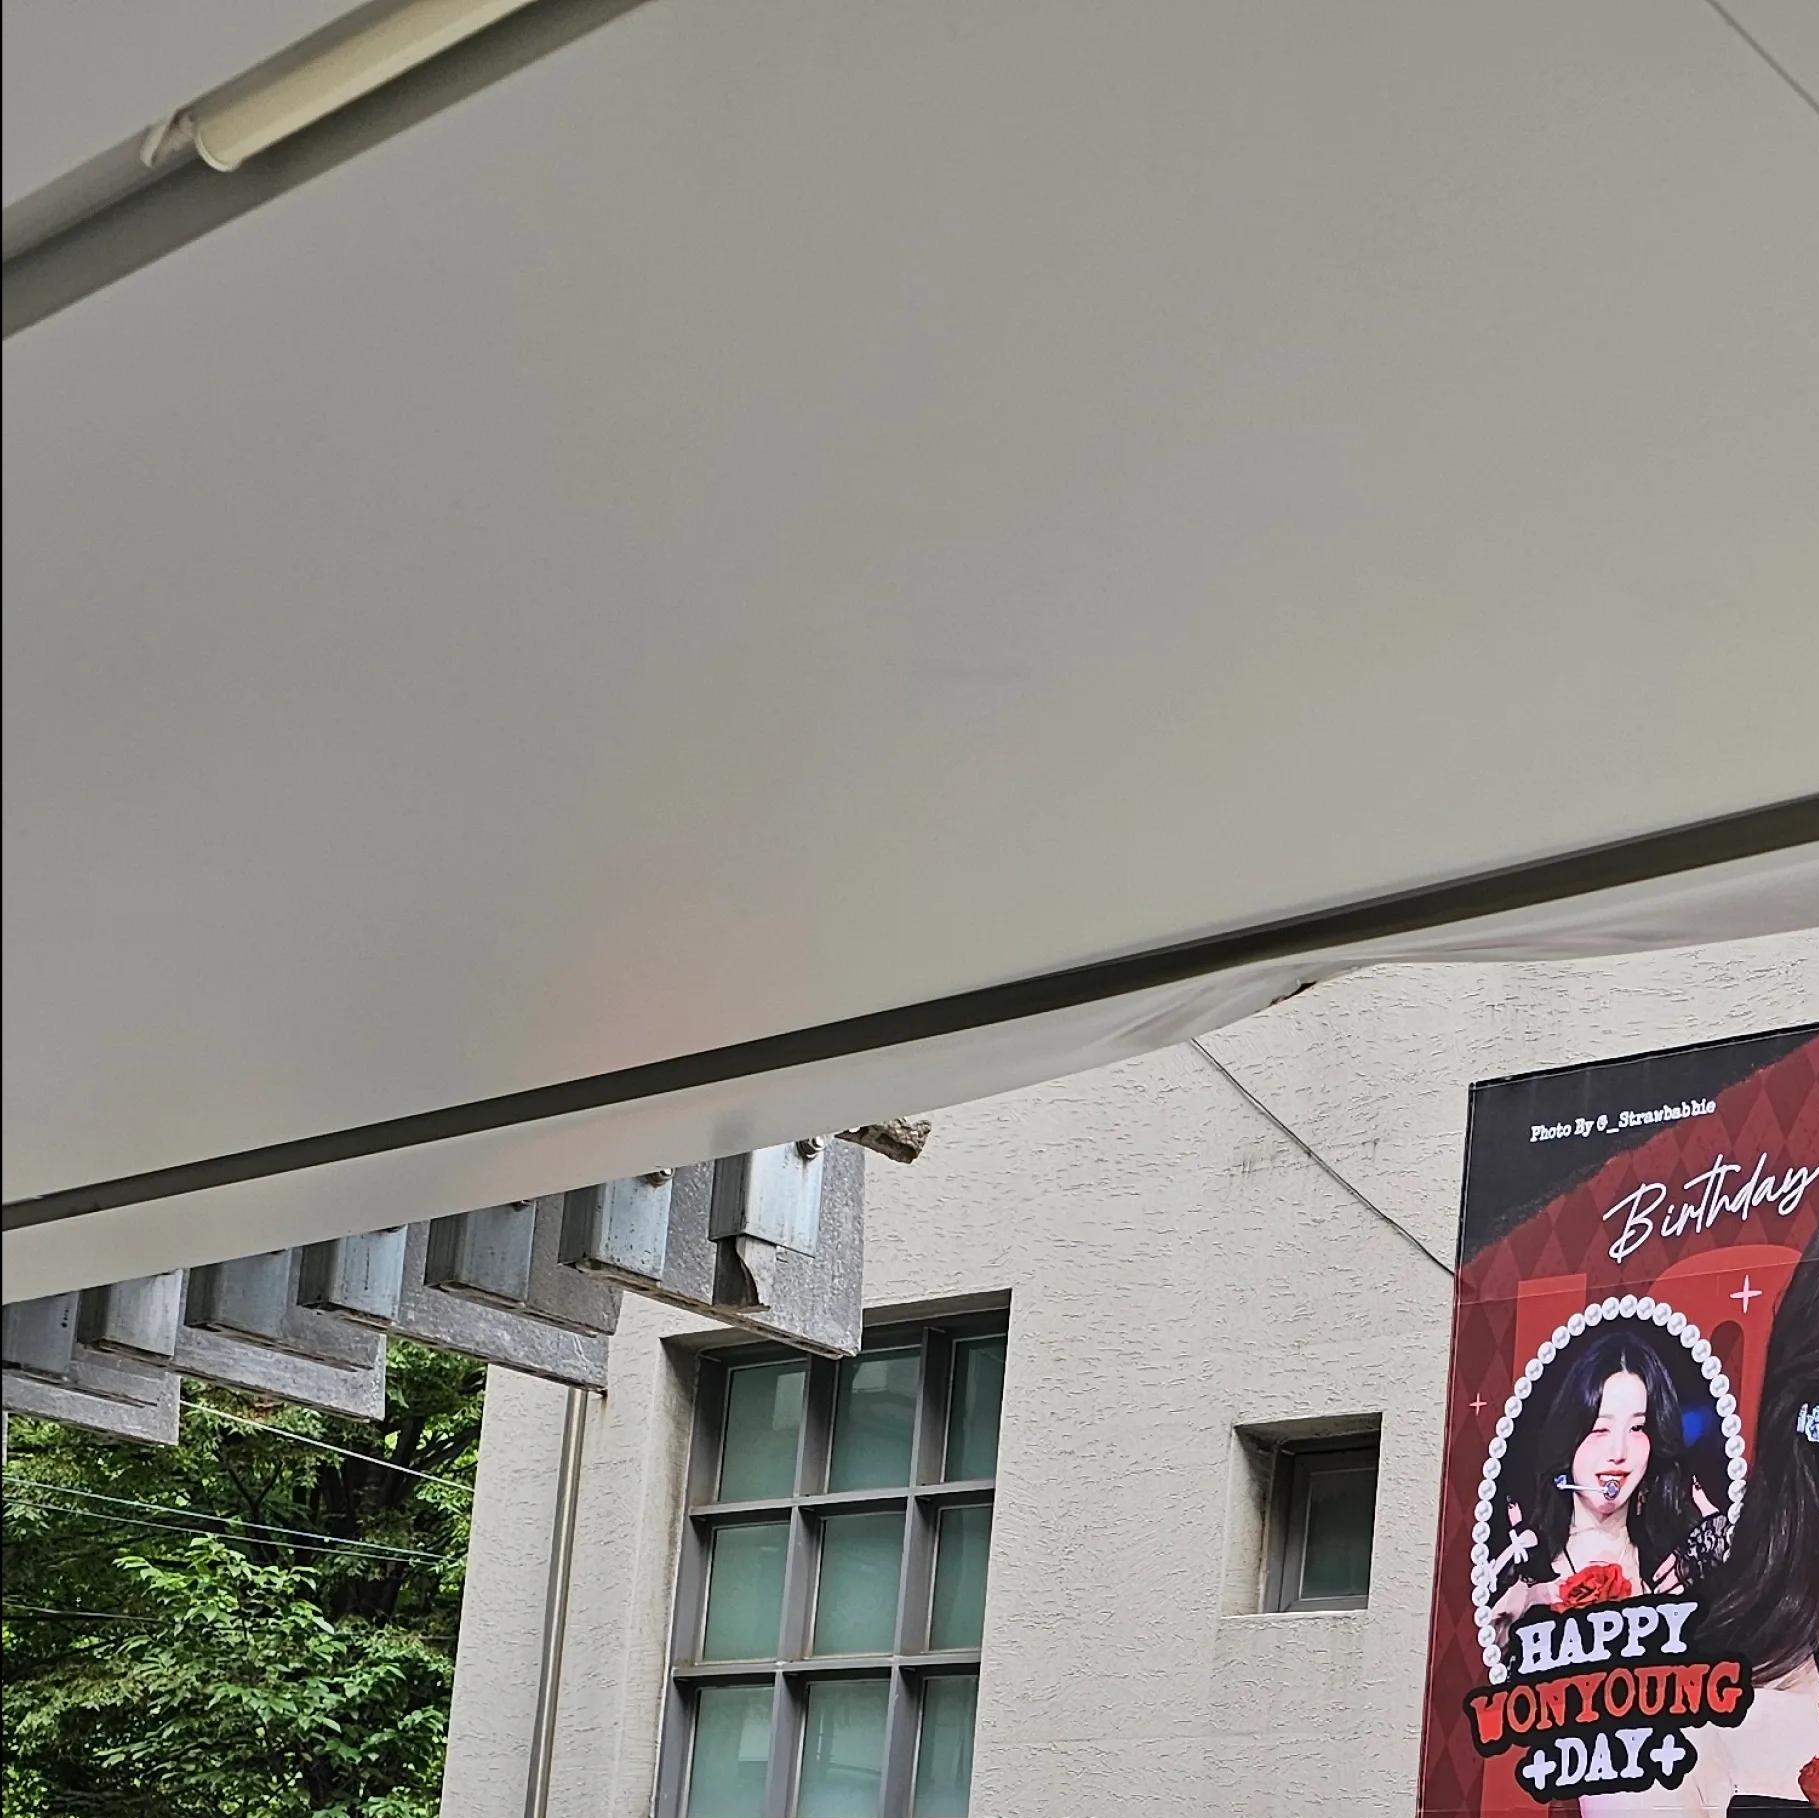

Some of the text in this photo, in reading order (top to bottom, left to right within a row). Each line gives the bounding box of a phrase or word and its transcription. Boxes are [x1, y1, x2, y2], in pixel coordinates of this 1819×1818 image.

[1530, 1122, 1572, 1142] Photo
[1574, 1118, 1594, 1138] By
[1515, 1602, 1698, 1675] HAPPY
[1470, 1661, 1742, 1744] WONYOUNG
